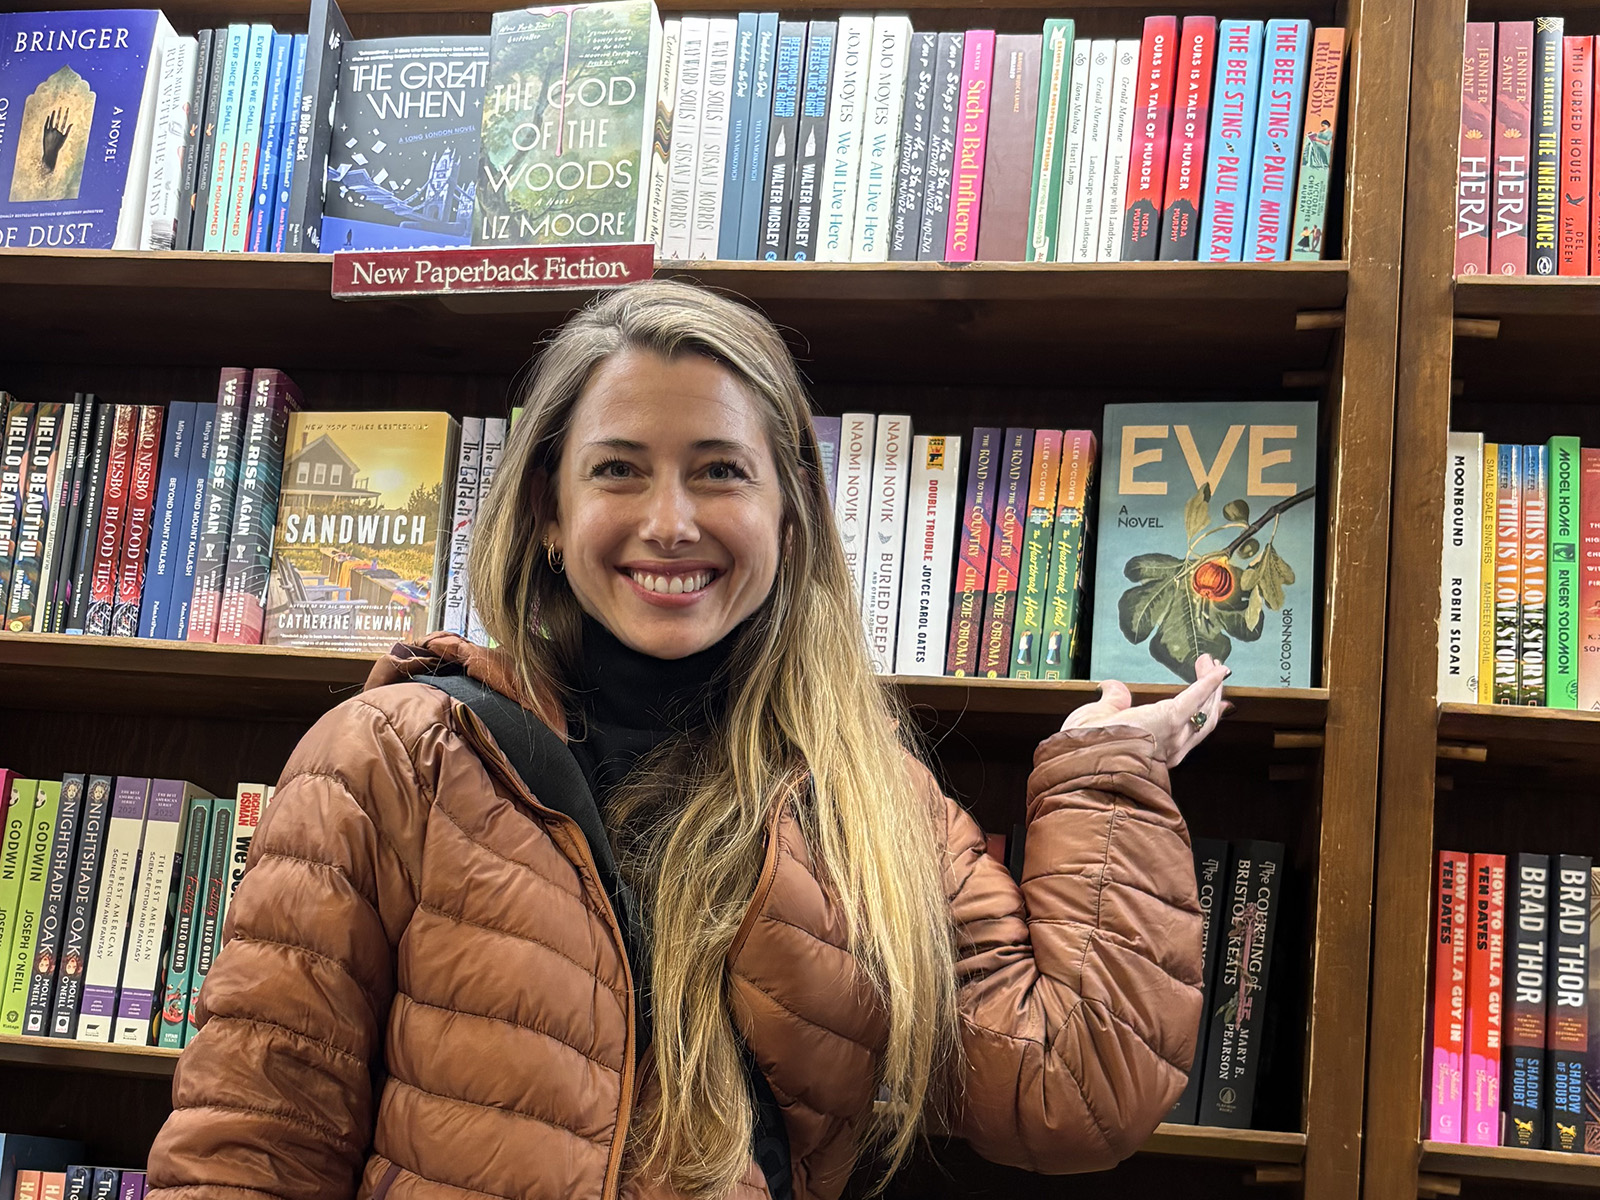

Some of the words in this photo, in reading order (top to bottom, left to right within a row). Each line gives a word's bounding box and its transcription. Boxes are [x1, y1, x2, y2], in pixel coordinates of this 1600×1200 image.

[14, 28, 128, 52] BRINGER
[846, 28, 860, 66] JOJO
[920, 36, 934, 67] Your
[1152, 35, 1164, 66] OURS
[1229, 25, 1250, 53] THE
[229, 61, 238, 86] SINCE
[350, 64, 394, 91] THE
[401, 61, 489, 89] GREAT
[1151, 70, 1160, 79] IS
[1226, 60, 1247, 85] BEE
[1502, 56, 1513, 92] SAINT
[1516, 47, 1528, 102] JENNIFER
[1572, 47, 1583, 72] THIS
[226, 89, 234, 102] WE
[494, 82, 533, 115] THE
[547, 76, 636, 109] GOD
[840, 71, 856, 122] MOYES
[914, 71, 931, 110] Steps
[1310, 42, 1330, 117] RHAPSODY
[1323, 50, 1341, 108] HARLEM
[301, 95, 312, 111] We
[366, 90, 466, 119] WHEN
[966, 80, 985, 119] Such
[1147, 93, 1158, 120] TALE
[1221, 91, 1244, 139] STING
[1571, 80, 1582, 131] CURSED
[222, 105, 232, 134] SMALL
[299, 114, 311, 135] Bite
[406, 134, 423, 142] LONG
[426, 129, 452, 140] LONDON
[454, 125, 476, 134] NOVEL
[512, 121, 553, 150] OF
[568, 119, 609, 149] THE
[914, 114, 922, 132] on
[964, 123, 977, 132] a
[1146, 123, 1155, 139] OF
[105, 119, 121, 162] NOVEL
[296, 136, 309, 161] Back
[837, 131, 851, 154] We
[912, 137, 925, 160] the
[961, 138, 980, 169] Bad
[1538, 132, 1557, 155] THE
[217, 142, 228, 182] CELESTE
[484, 160, 632, 192] WOODS
[835, 159, 848, 176] All
[1140, 143, 1153, 190] MURDER
[1216, 156, 1240, 194] PAUL
[1570, 138, 1581, 182] HOUSE
[770, 164, 786, 203] WALTER
[832, 182, 846, 209] Live
[906, 165, 922, 210] Stairs
[1497, 156, 1524, 239] HERA
[211, 186, 222, 236] MOHAMMED
[953, 175, 977, 252] Influence
[1536, 162, 1555, 249] INHERITANCE
[28, 223, 93, 247] DUST
[482, 216, 510, 239] LIZ
[520, 212, 626, 237] MOORE
[766, 206, 782, 247] MOSLEY
[828, 214, 843, 249] Here
[351, 262, 410, 285] New
[414, 257, 539, 290] Paperback
[544, 256, 630, 280] Fiction
[224, 378, 237, 406] WE
[33, 417, 56, 465] HELLO
[218, 412, 237, 442] WILL
[463, 442, 480, 462] The
[885, 422, 900, 470] NAOMI
[1118, 425, 1298, 497] EVE
[109, 450, 126, 499] NESBØ
[212, 445, 229, 489] RISE
[1559, 448, 1571, 494] MODEL
[167, 478, 177, 509] BEYOND
[457, 466, 478, 517] Garden
[881, 476, 896, 522] NOVIK
[927, 480, 938, 516] DOUBLE
[1453, 456, 1465, 547] MOONBOUND
[18, 472, 48, 560] BEAUTIFUL
[162, 510, 172, 539] MOUNT
[207, 494, 222, 534] AGAIN
[1118, 505, 1129, 515] A
[1118, 518, 1164, 528] NOVEL
[1559, 496, 1570, 536] HOME
[101, 507, 119, 557] BLOOD
[285, 514, 426, 544] SANDWICH
[924, 519, 936, 561] TROUBLE
[158, 541, 168, 575] KAILASH
[453, 534, 469, 562] Nick
[96, 560, 111, 593] TIES
[448, 561, 464, 608] Newman
[878, 553, 893, 610] BURIED
[921, 565, 932, 596] JOYCE
[1056, 541, 1072, 594] Heartbreak
[11, 570, 24, 613] NAPOLITANO
[961, 567, 976, 618] CHIGOZIE
[1451, 578, 1462, 622] ROBIN
[1558, 569, 1569, 608] RIVERS
[278, 614, 350, 630] CATHERINE
[354, 615, 411, 631] NEWMAN
[918, 599, 929, 629] CAROL
[1052, 596, 1068, 627] Hotel
[875, 615, 888, 653] DEEP
[916, 633, 927, 662] OATES
[955, 620, 971, 666] OBIOMA
[1280, 608, 1293, 671] O'CONNOR
[1450, 629, 1460, 675] SLOAN
[1558, 611, 1570, 674] SOLOMON
[238, 793, 252, 826] OSMAN
[249, 793, 261, 827] RICHARD
[30, 822, 50, 882] GODWIN
[49, 801, 76, 902] NIGHTSHADE
[120, 852, 128, 871] THE
[116, 876, 125, 898] BEST
[1259, 861, 1275, 884] The
[1443, 861, 1453, 889] TEN
[1456, 862, 1466, 900] HOW
[49, 905, 58, 914] &
[1231, 860, 1250, 924] BRISTOL
[1560, 870, 1586, 934] BRAD
[20, 910, 34, 949] JOSEPH
[107, 903, 120, 957] AMERICAN
[179, 918, 189, 942] NUZO
[1249, 887, 1270, 972] COURTING
[1441, 894, 1452, 944] DATES
[1454, 904, 1465, 923] TO
[40, 916, 57, 954] OAK
[1453, 929, 1464, 965] KILL
[12, 952, 27, 993] O'NEILL
[176, 944, 184, 968] ONOH
[1224, 937, 1241, 985] KEATS
[31, 975, 42, 1007] O'NEILL
[1452, 968, 1462, 981] A
[1558, 944, 1585, 1008] THOR
[40, 979, 50, 1008] MOLLY
[1451, 986, 1462, 1020] GUY
[1236, 1028, 1249, 1064] MARY
[1450, 1024, 1461, 1042] IN
[1219, 1024, 1234, 1079] PEARSON
[1515, 1058, 1524, 1068] OF
[1513, 1071, 1525, 1107] DOUBT
[1526, 1058, 1539, 1110] SHADOW
